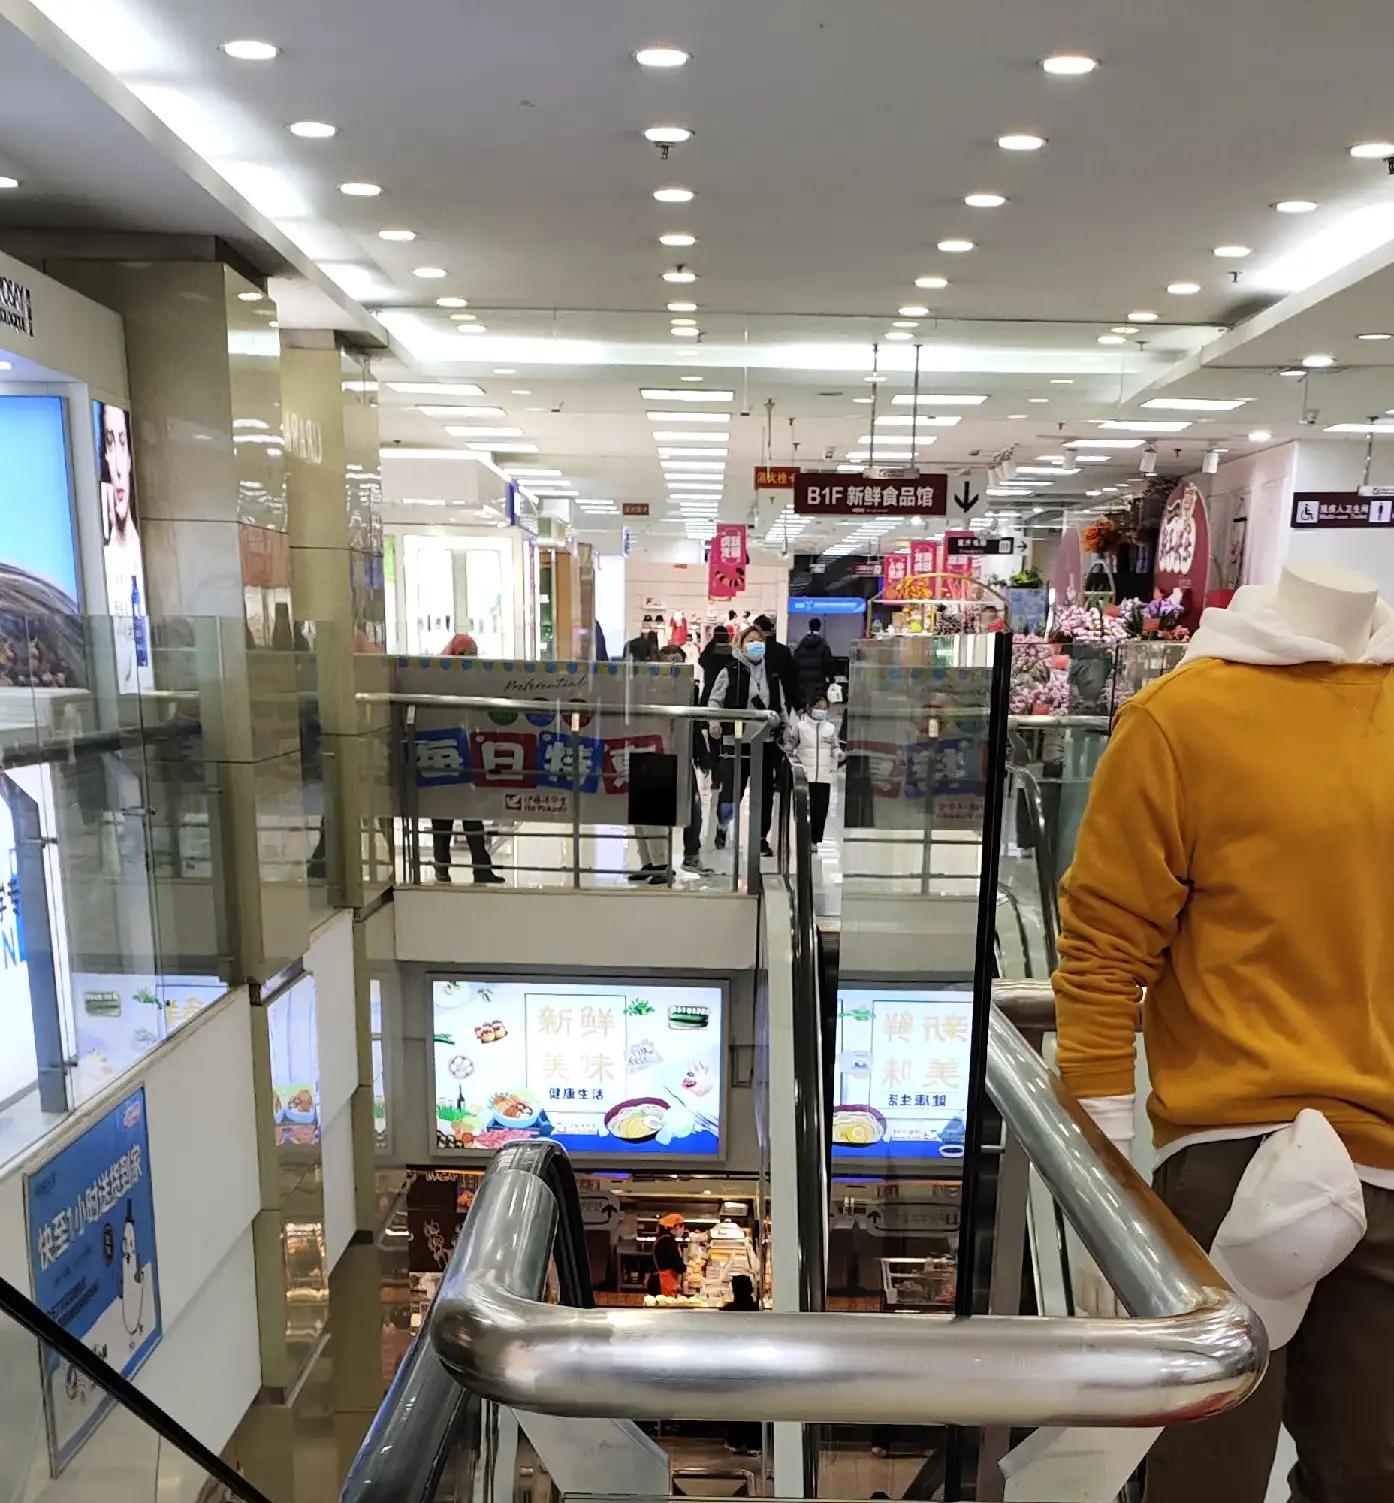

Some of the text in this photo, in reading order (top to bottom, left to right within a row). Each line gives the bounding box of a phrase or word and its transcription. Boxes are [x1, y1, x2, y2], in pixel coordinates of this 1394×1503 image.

[807, 486, 935, 507] B1F 新鲜食品馆
[537, 1005, 616, 1038] 新鲜
[541, 1052, 617, 1083] 美味
[549, 1087, 604, 1100] 健康生活
